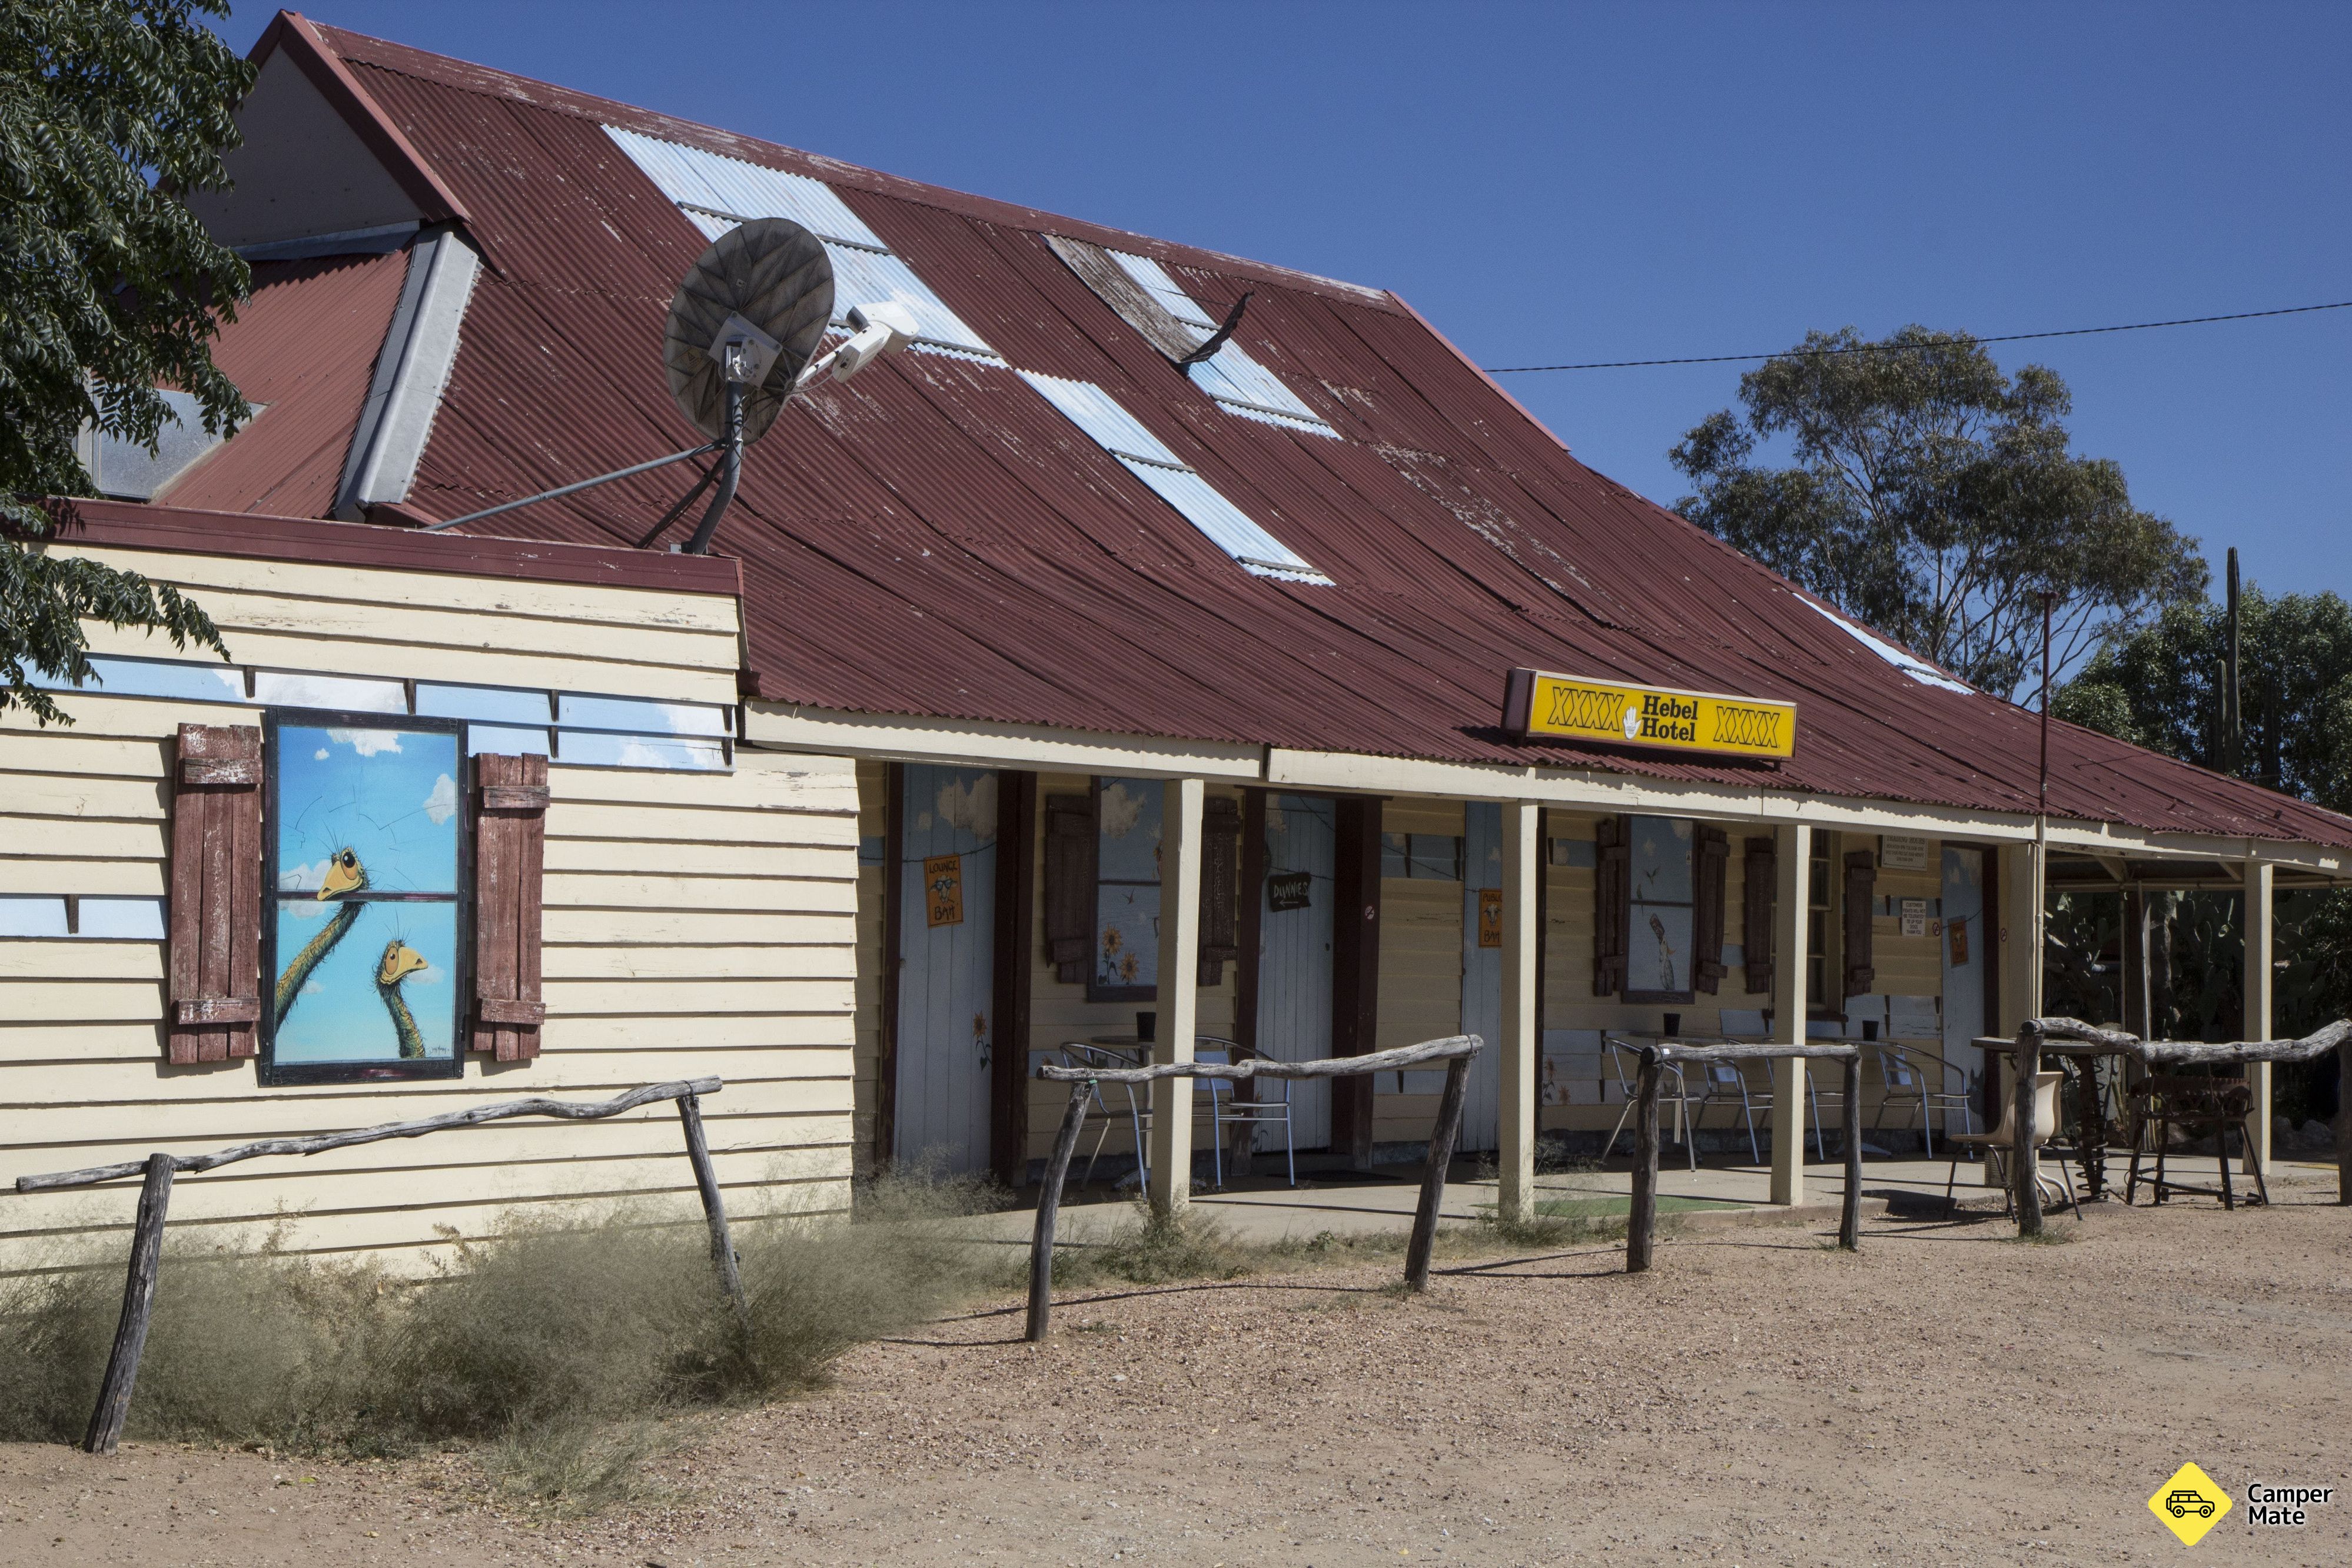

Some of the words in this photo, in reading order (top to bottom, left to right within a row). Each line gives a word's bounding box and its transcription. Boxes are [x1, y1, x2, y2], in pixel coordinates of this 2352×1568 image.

[1547, 686, 1624, 732] XXXX
[1643, 695, 1699, 720] Hebel
[1640, 717, 1696, 742] Hotel
[1713, 706, 1780, 748] XXXX
[929, 861, 958, 874] LOUNGE
[1274, 881, 1308, 899] DUNNIES
